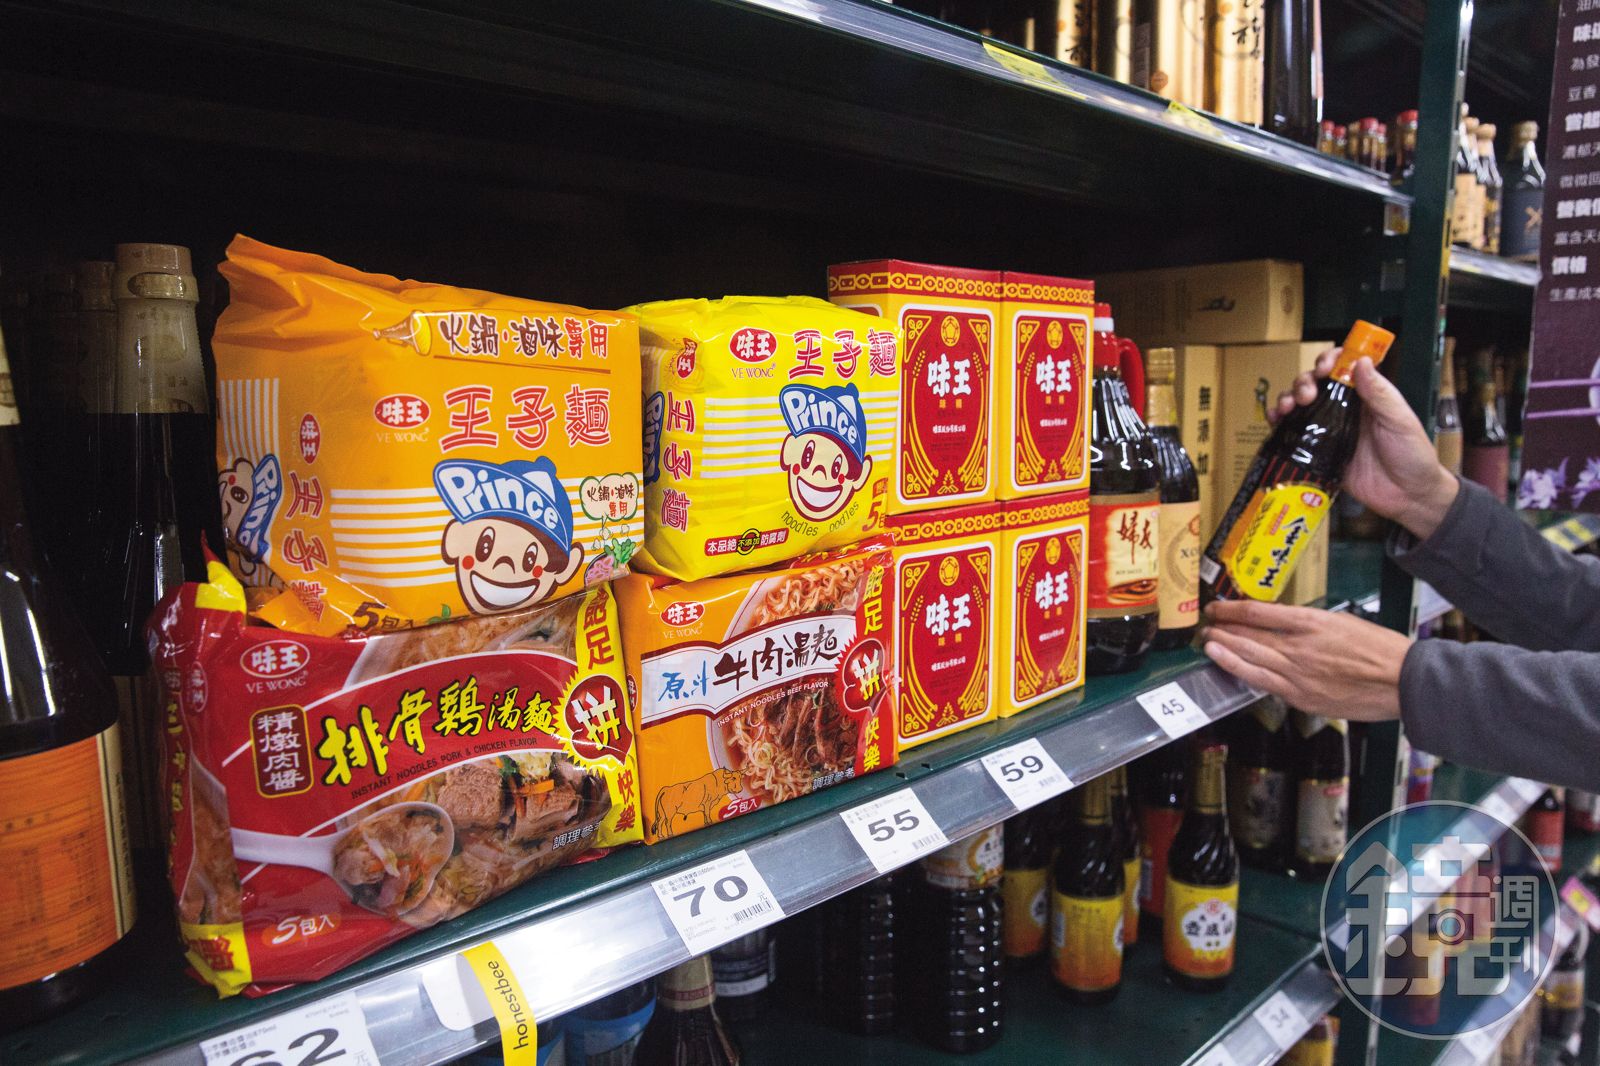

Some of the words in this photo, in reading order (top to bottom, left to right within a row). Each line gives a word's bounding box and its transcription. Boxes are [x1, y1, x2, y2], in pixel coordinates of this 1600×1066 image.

[1554, 229, 1600, 246] 富含天
[731, 367, 745, 379] VE
[747, 366, 774, 379] WONG
[737, 330, 774, 358] 味王
[788, 328, 897, 380] 王子麵
[928, 353, 972, 397] 味王
[1035, 354, 1072, 395] 味王
[301, 420, 319, 458] 味王
[375, 432, 392, 443] VE
[394, 431, 428, 443] WONG
[381, 398, 426, 427] 味王
[439, 384, 611, 453] 王子麵
[784, 390, 859, 445] Prince
[660, 391, 695, 532] 王子麵
[238, 459, 279, 550] Princ
[437, 467, 560, 531] Prince
[609, 501, 628, 517] 專用
[781, 510, 819, 537] noodles
[862, 565, 884, 636] 飽足
[1035, 571, 1069, 610] 味王
[663, 630, 675, 639] VE
[676, 626, 703, 637] WONG
[667, 603, 699, 624] 味王
[925, 593, 972, 636] 味王
[251, 645, 301, 673] 味王
[658, 660, 707, 702] 原汁
[713, 624, 840, 691] 牛肉湯麵
[852, 648, 883, 701] 拼
[245, 682, 264, 694] VE
[266, 679, 307, 692] WONG
[717, 705, 749, 728] INSTANT
[750, 691, 786, 709] NOODLES
[787, 685, 803, 696] BEEF
[803, 681, 829, 691] FLAVOR
[1162, 698, 1185, 716] 45
[571, 684, 622, 751] 拼
[257, 711, 306, 791] 精燉肉醬
[863, 721, 882, 771] 快樂
[351, 776, 393, 800] INSTANT
[396, 758, 439, 780] NOODLES
[440, 751, 463, 764] PORK
[465, 749, 471, 757] &
[473, 740, 507, 754] CHICKEN
[508, 737, 538, 748] FLAVOR
[1000, 755, 1044, 783] 59
[614, 769, 637, 834] 快樂
[722, 796, 758, 818] 5包入
[867, 808, 920, 842] 55
[673, 875, 749, 918] 70
[271, 914, 335, 945] 5包入
[487, 960, 529, 1050] honestbee
